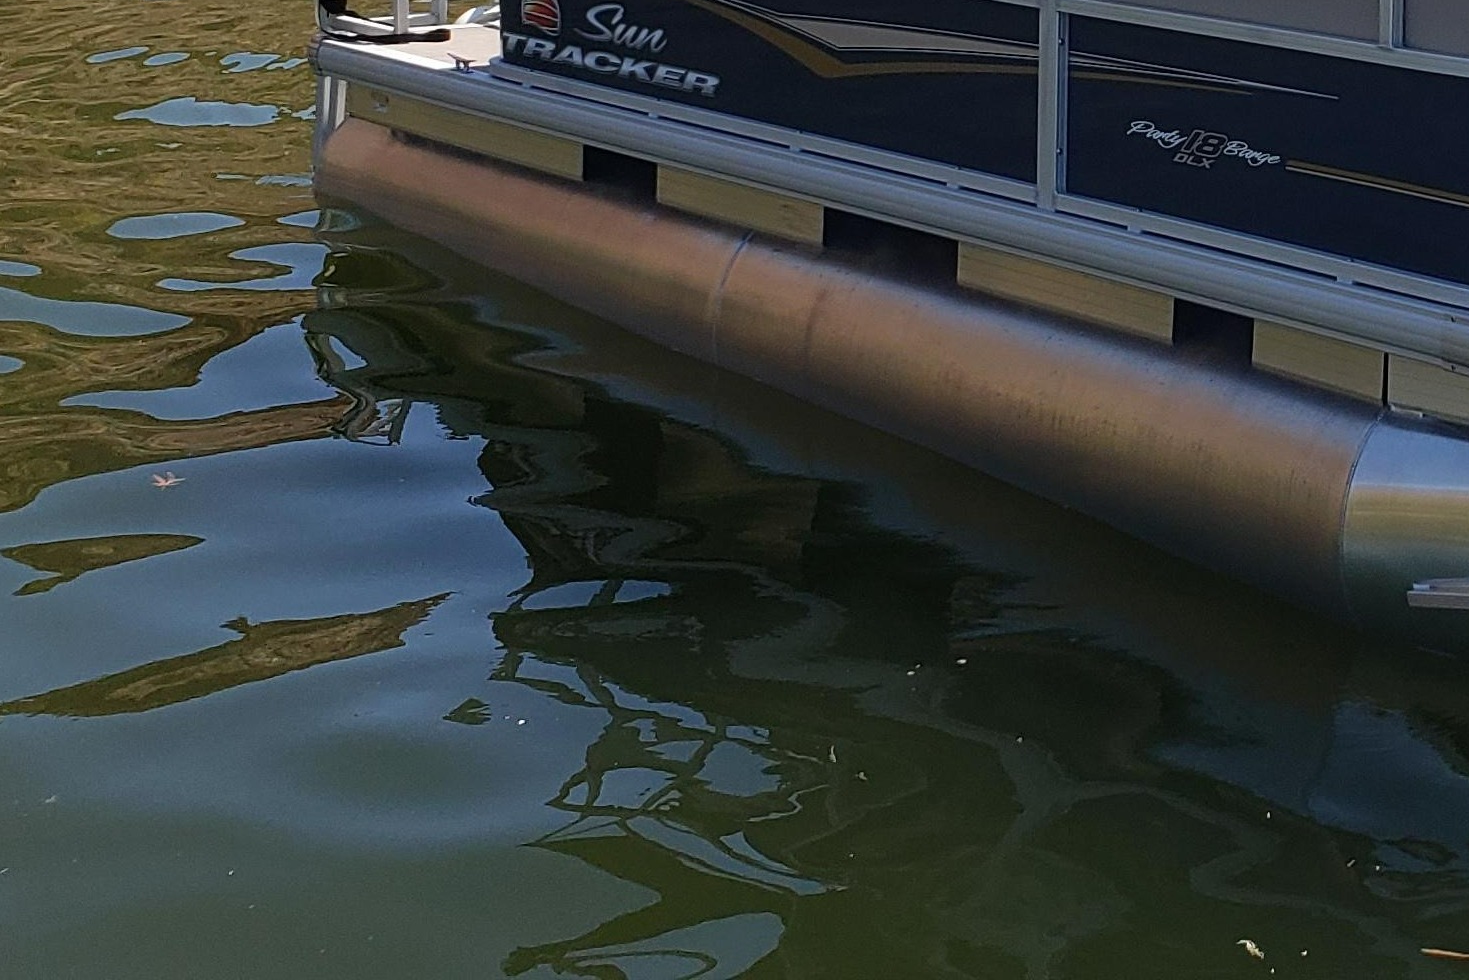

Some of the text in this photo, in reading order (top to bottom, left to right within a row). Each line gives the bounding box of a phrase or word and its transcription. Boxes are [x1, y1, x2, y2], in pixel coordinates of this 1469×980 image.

[573, 3, 668, 54] Sun
[502, 31, 721, 97] TRACKER
[1126, 120, 1282, 167] Party 18 Barge
[1173, 152, 1218, 169] DLX
